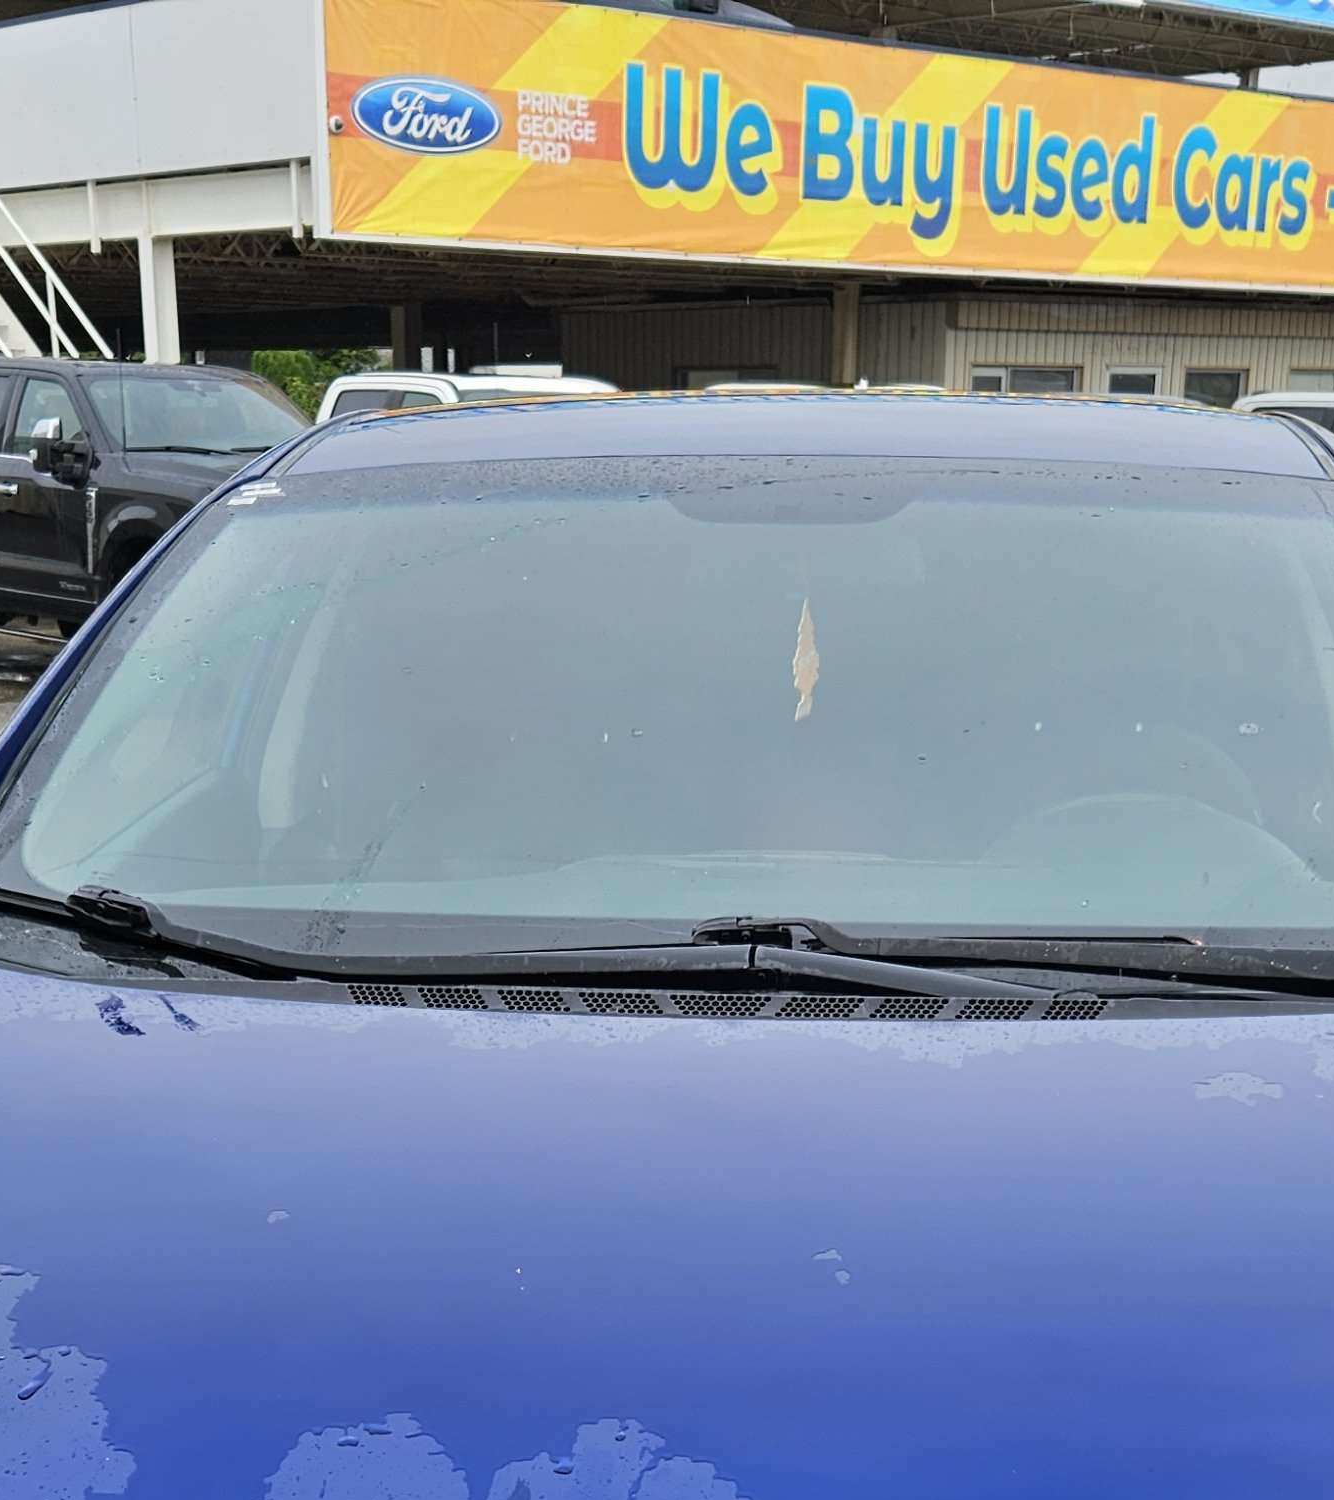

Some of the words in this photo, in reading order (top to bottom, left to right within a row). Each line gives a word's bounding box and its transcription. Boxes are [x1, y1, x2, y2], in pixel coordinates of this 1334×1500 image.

[382, 86, 474, 144] Ford
[518, 89, 589, 117] PRINCE
[518, 115, 596, 143] GEORGE
[518, 139, 571, 164] FORD
[624, 63, 774, 197] We
[801, 84, 956, 240] Buy
[981, 104, 1156, 225] Used
[1172, 126, 1312, 236] Cars
